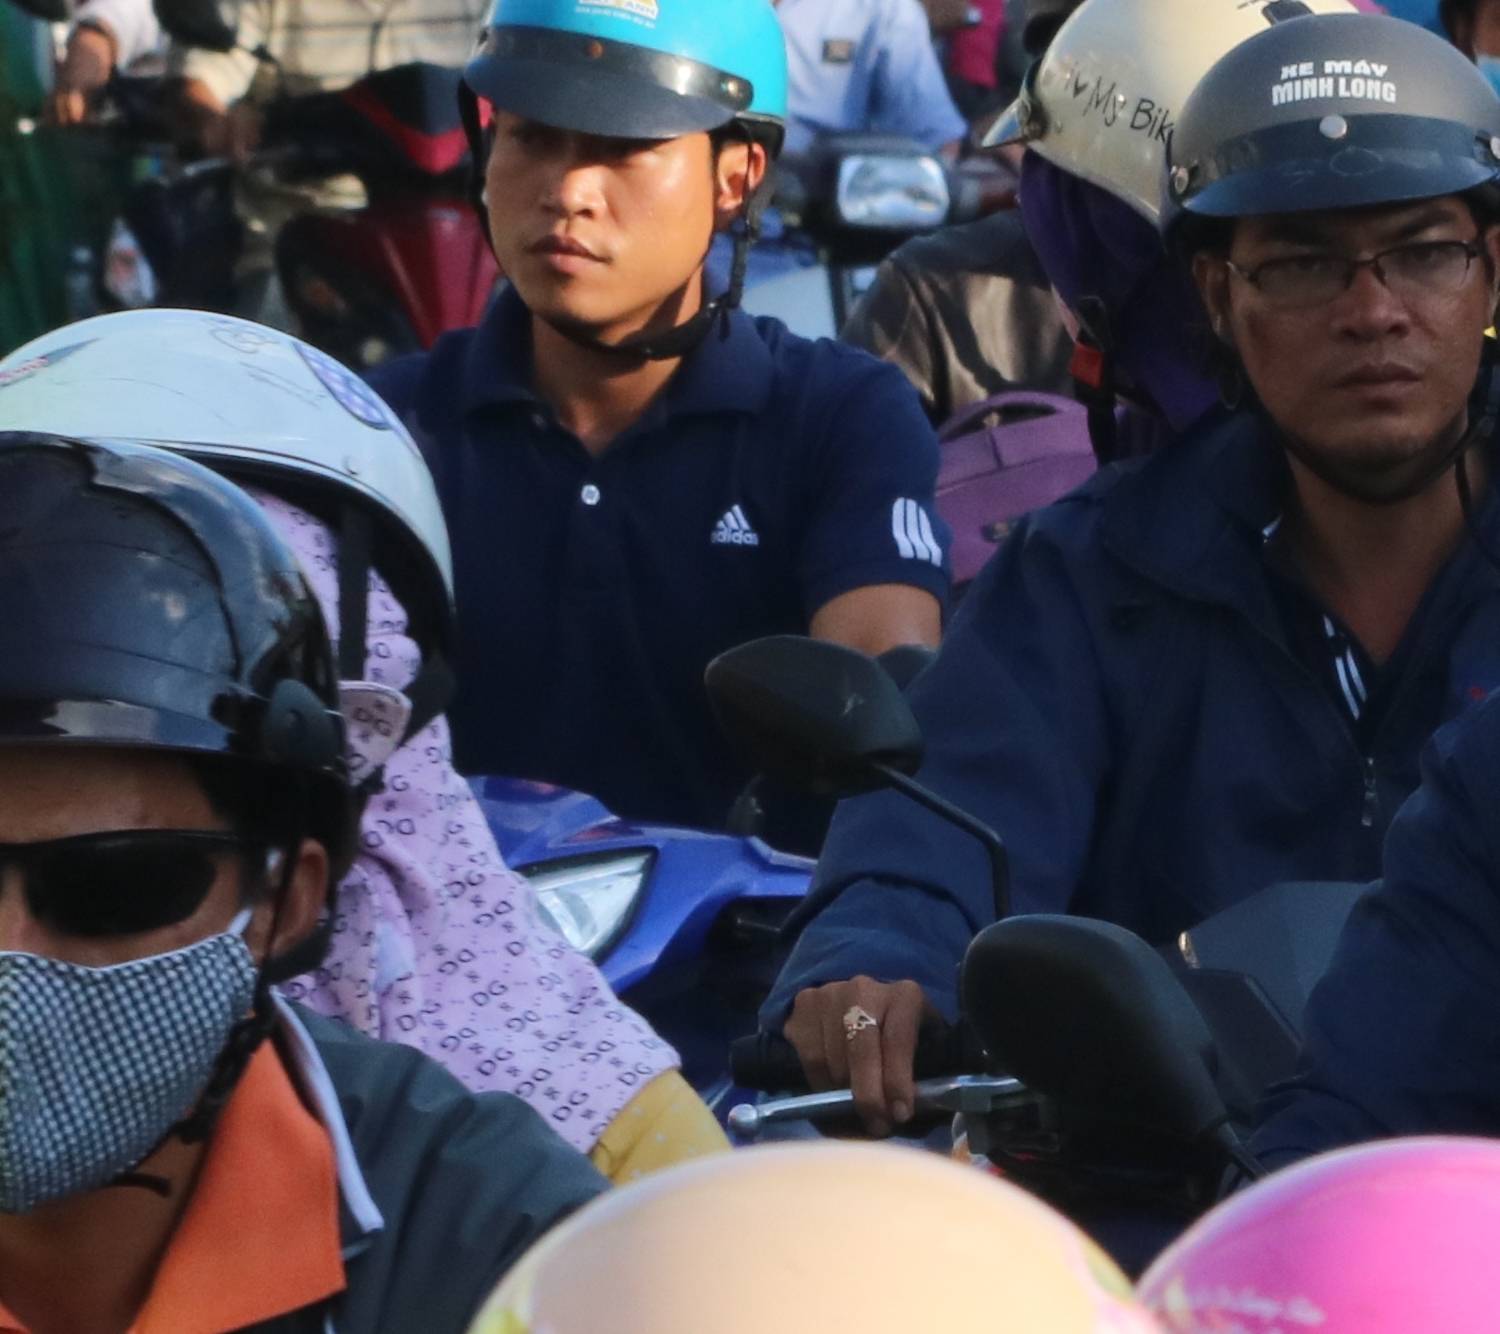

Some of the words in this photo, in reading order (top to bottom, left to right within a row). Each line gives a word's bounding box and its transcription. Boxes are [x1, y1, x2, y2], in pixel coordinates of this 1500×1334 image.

[1281, 62, 1315, 79] XE
[1324, 59, 1388, 77] MÁY
[1272, 77, 1335, 106] MINH
[1338, 75, 1398, 104] LONG
[711, 528, 759, 546] adidas
